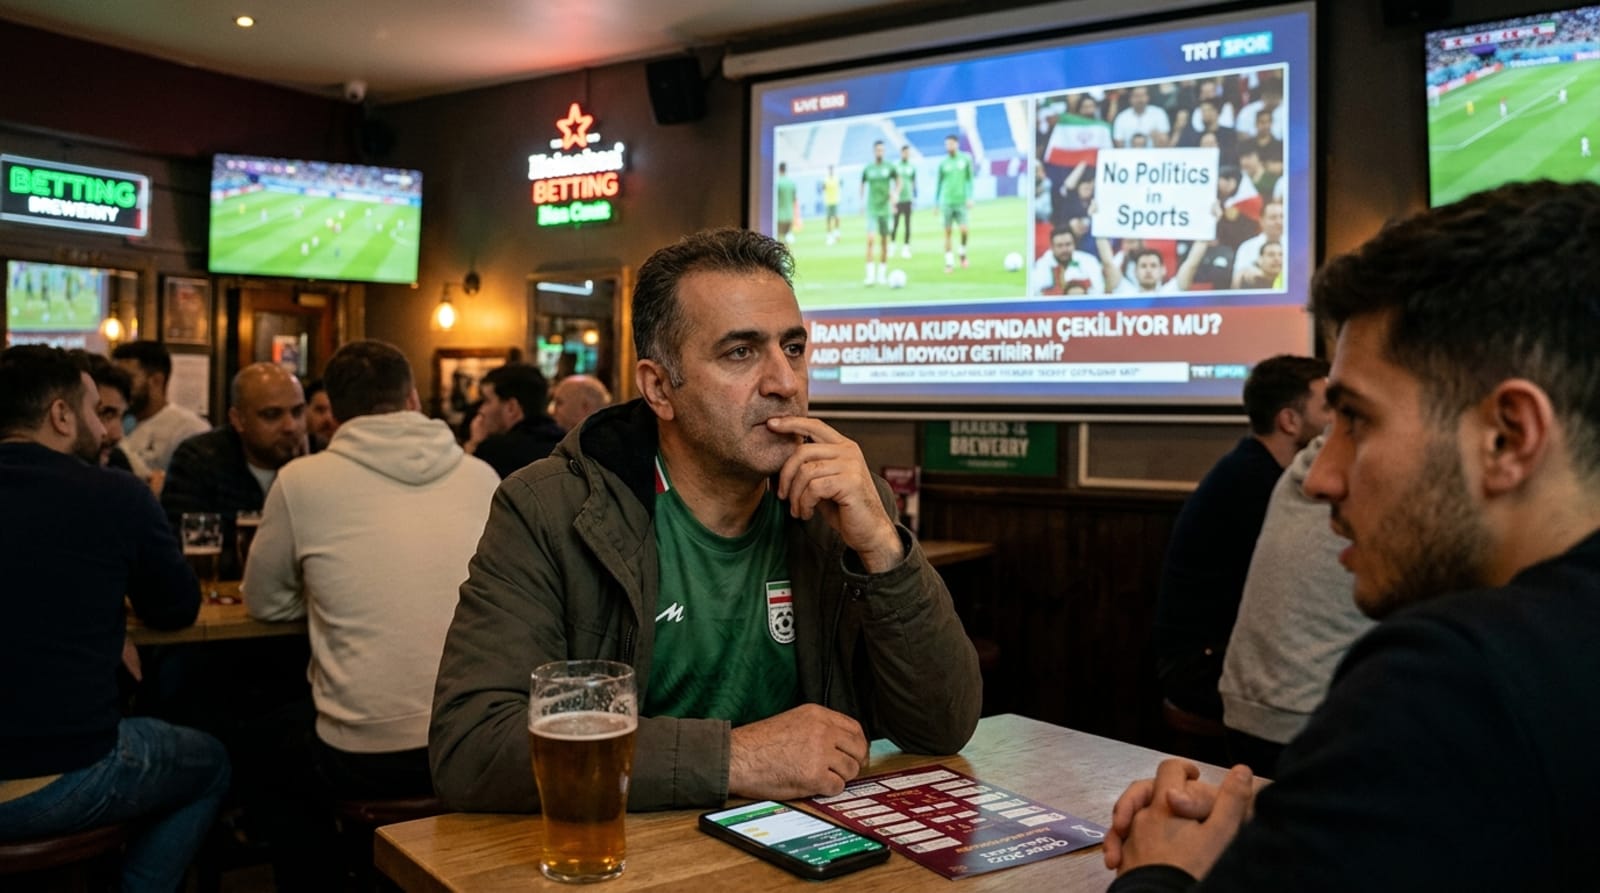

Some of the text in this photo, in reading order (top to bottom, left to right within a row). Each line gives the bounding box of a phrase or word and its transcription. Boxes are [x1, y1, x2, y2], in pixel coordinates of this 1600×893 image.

[1181, 34, 1268, 62] TRT SPOR
[9, 165, 136, 208] BETTING
[1103, 162, 1210, 184] No Politics
[533, 172, 619, 204] BETTING
[1146, 187, 1162, 203] in
[1117, 204, 1190, 230] Sports
[811, 312, 1223, 343] İRAN DÜNYA KUPASI'NDAN ÇEKİLİYOR MU?
